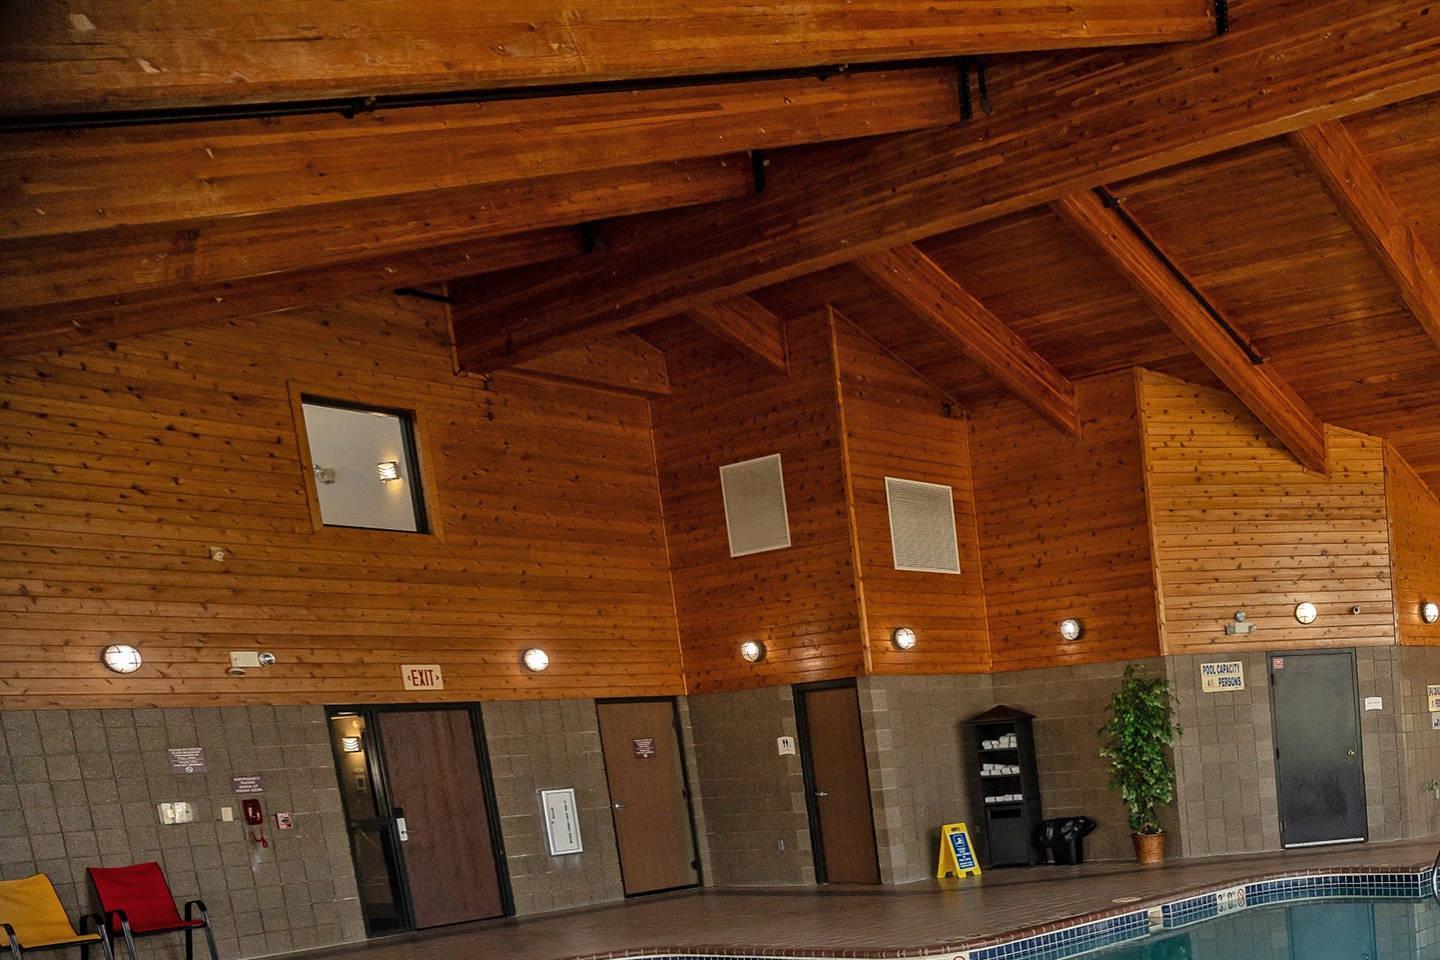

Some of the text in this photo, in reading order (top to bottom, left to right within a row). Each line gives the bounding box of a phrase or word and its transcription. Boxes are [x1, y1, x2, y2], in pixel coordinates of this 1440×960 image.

[1203, 663, 1240, 675] POOL CAPACITY
[410, 669, 434, 686] EXIT
[1219, 676, 1241, 687] PERSONS
